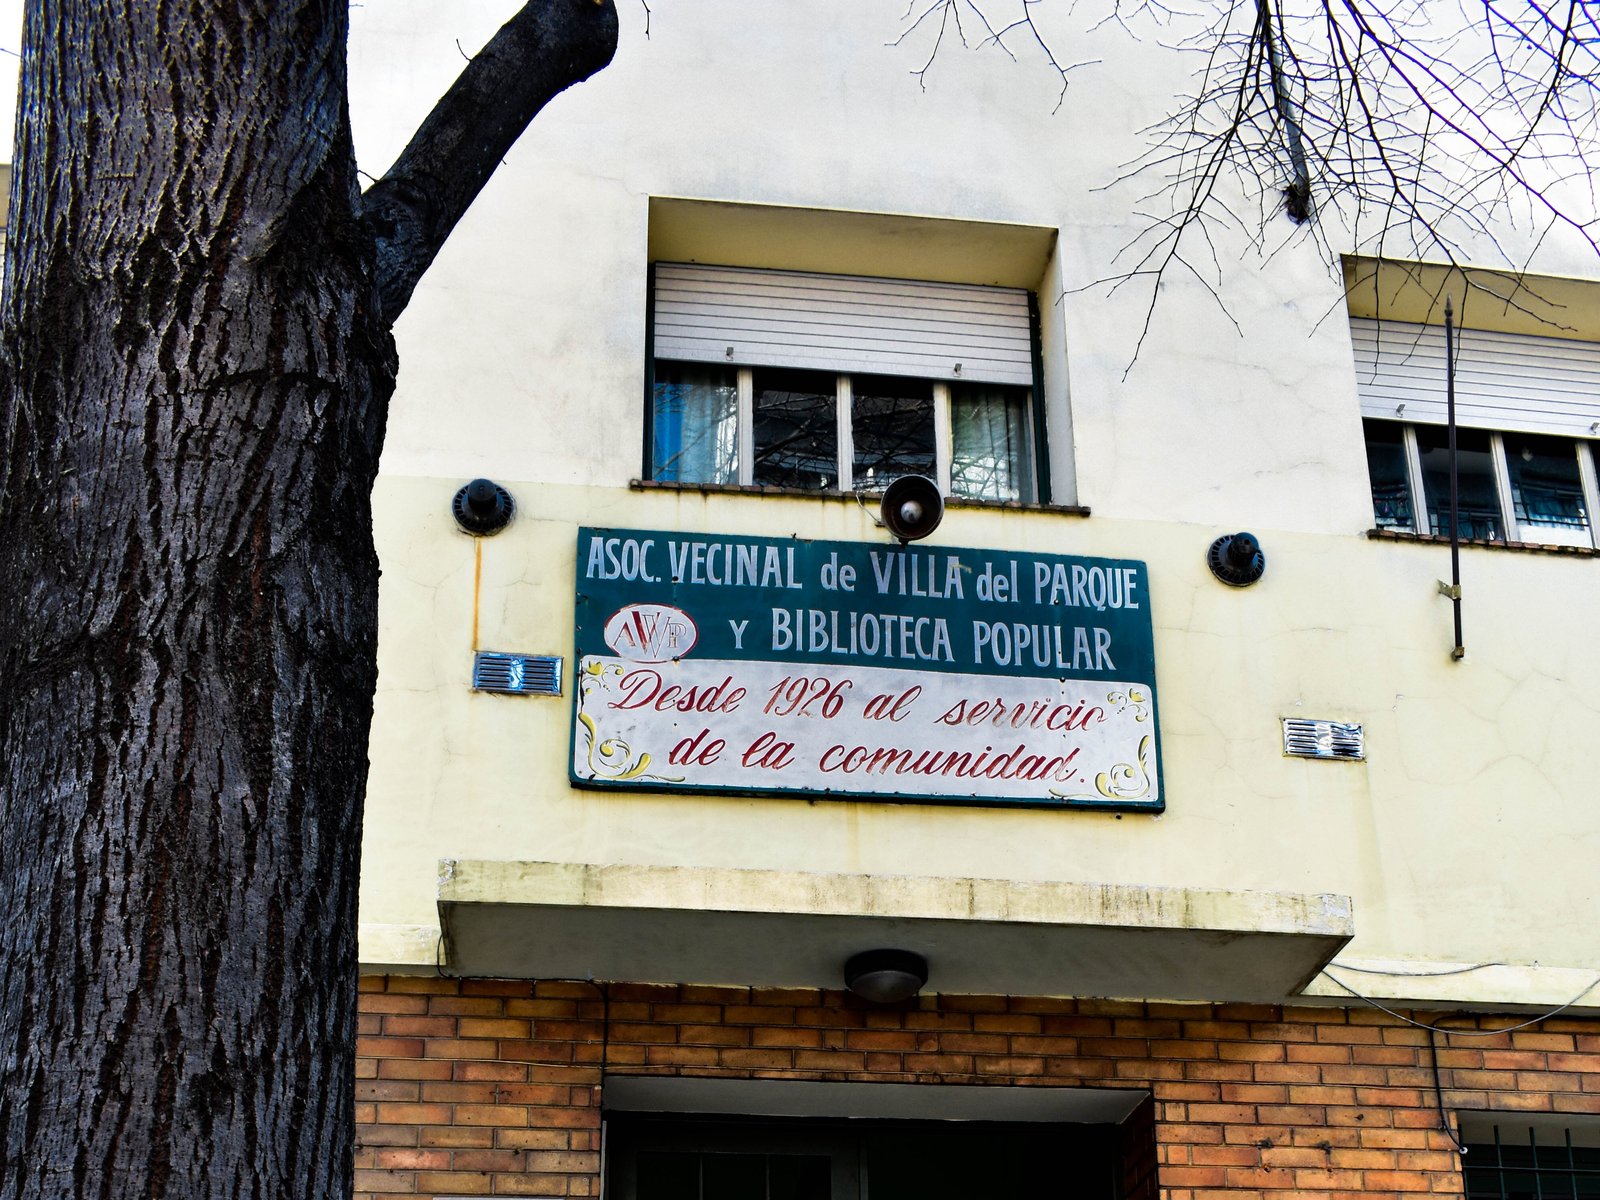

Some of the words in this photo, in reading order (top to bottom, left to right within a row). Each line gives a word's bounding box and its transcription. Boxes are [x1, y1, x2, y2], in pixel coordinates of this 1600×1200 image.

[585, 536, 662, 583] ASOC.
[668, 541, 803, 590] VECINAL
[820, 552, 857, 592] de
[869, 551, 965, 600] VILLA
[976, 560, 1019, 603] del
[1033, 561, 1140, 611] PARQUE
[728, 619, 750, 650] Y
[771, 607, 956, 663] BIBLIOTECA
[972, 620, 1117, 671] POPULAR
[607, 669, 747, 714] Desde
[762, 676, 854, 720] 1926
[862, 685, 923, 723] al
[933, 696, 1108, 731] servicio
[668, 728, 726, 767] de
[741, 731, 797, 770] la
[819, 743, 1086, 784] comunidad.
